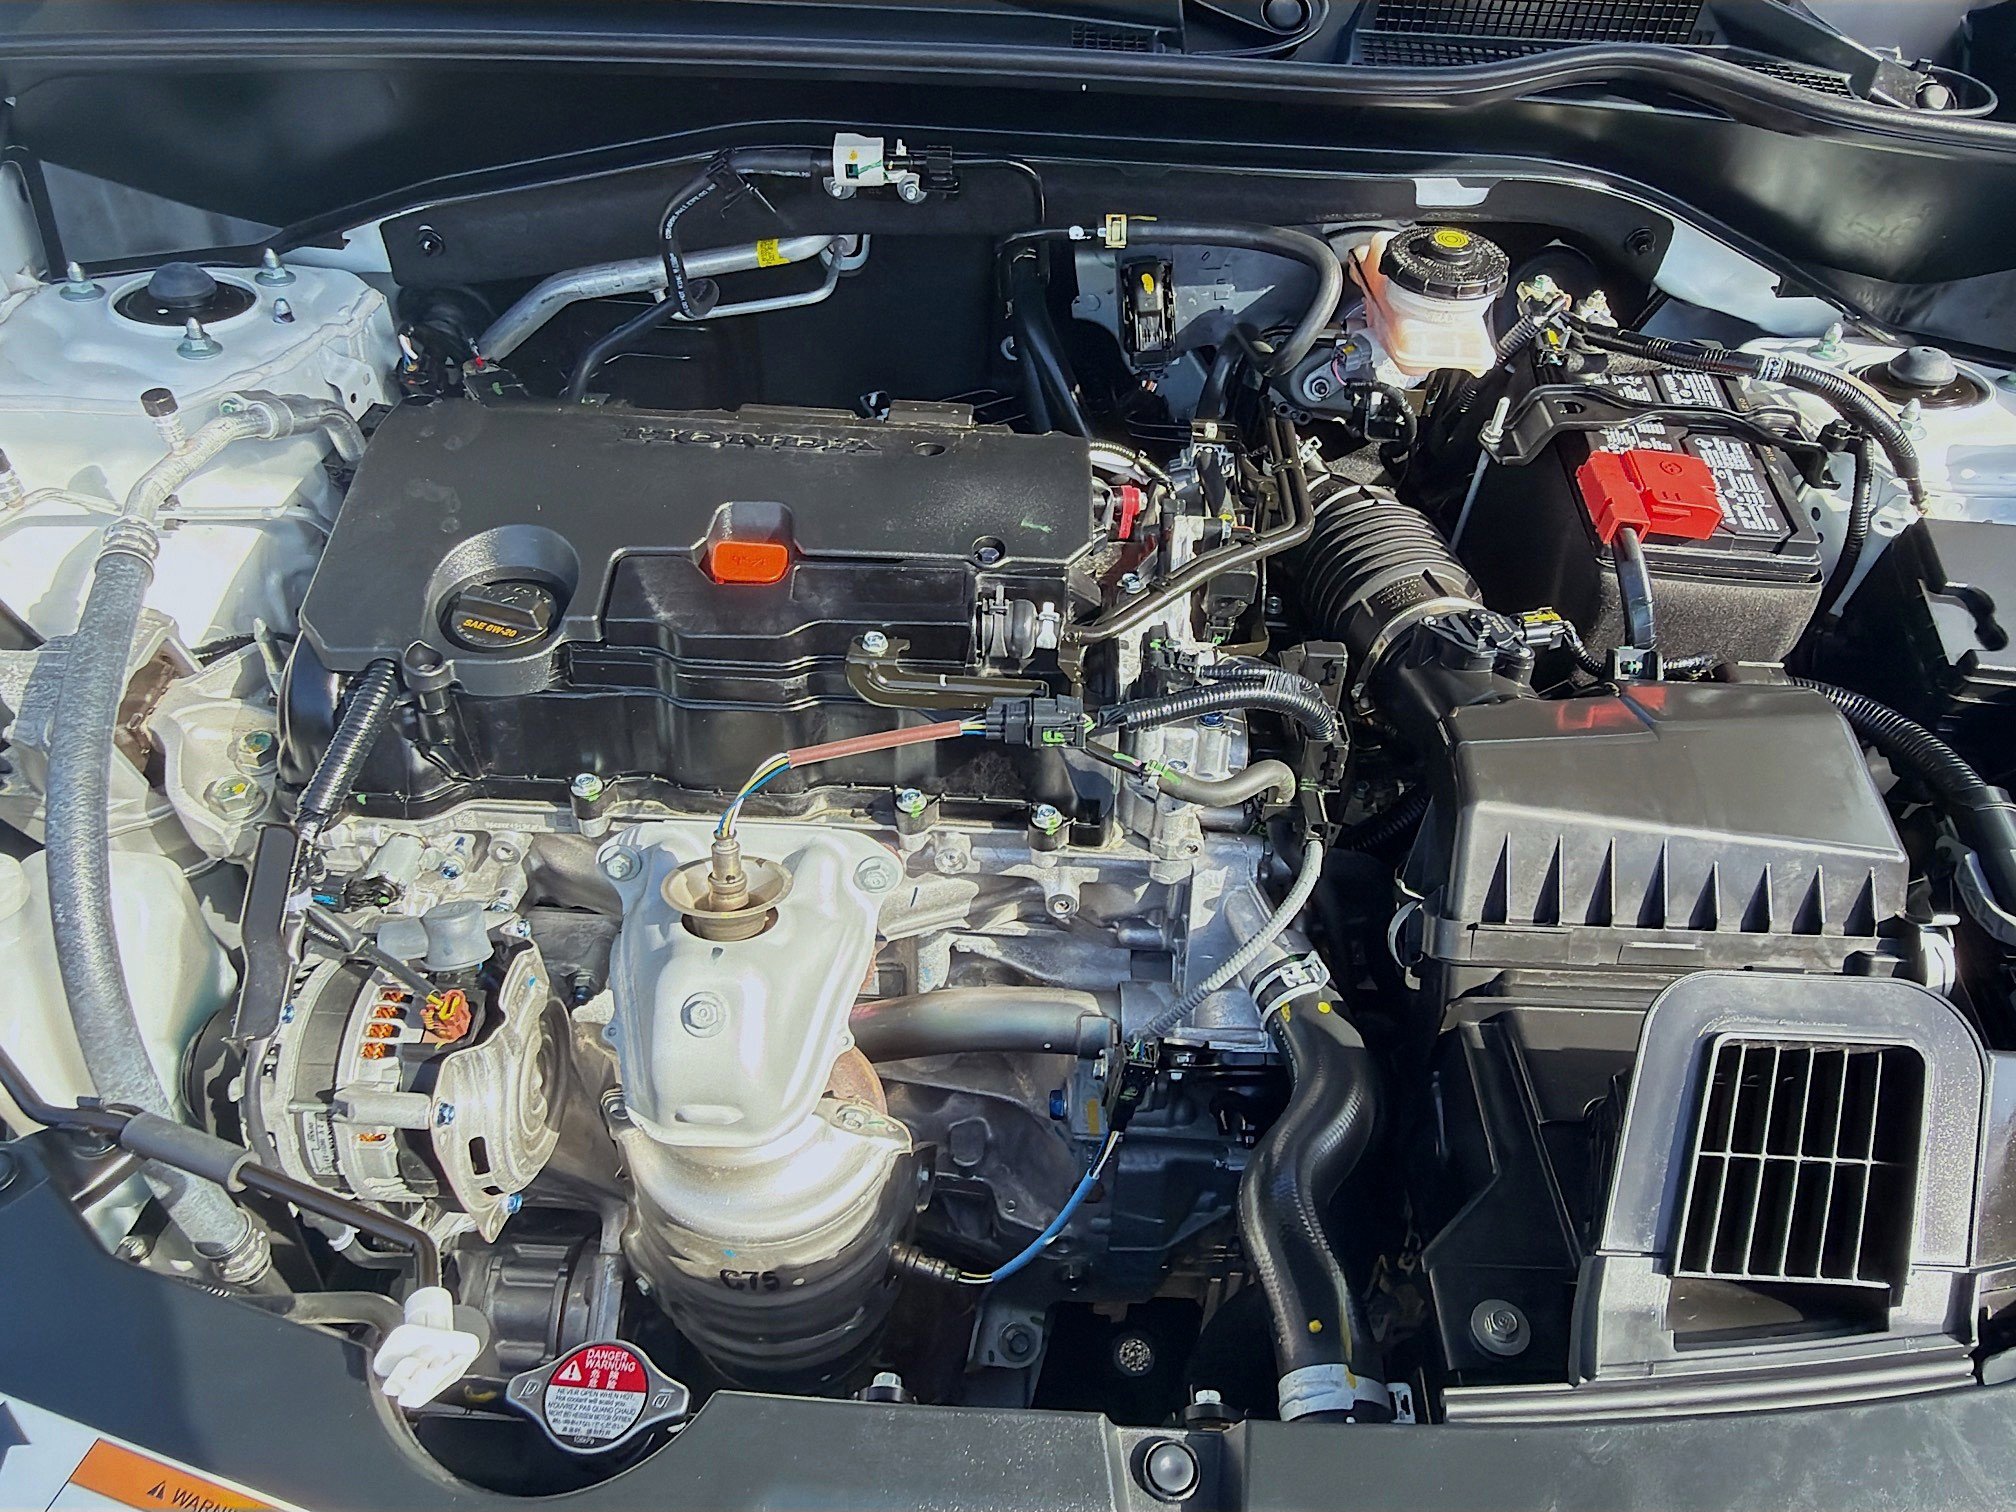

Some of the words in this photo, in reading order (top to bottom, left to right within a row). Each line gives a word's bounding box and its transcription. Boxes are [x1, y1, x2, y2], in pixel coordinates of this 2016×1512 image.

[463, 619, 486, 629] SAE
[485, 624, 518, 637] 0W-20
[587, 1349, 629, 1361] DANGER
[585, 1359, 636, 1372] WARNUNG
[557, 1388, 579, 1396] NEVER
[580, 1389, 599, 1397] OPEN
[600, 1391, 619, 1399] WHEN
[592, 1405, 614, 1413] QUAND
